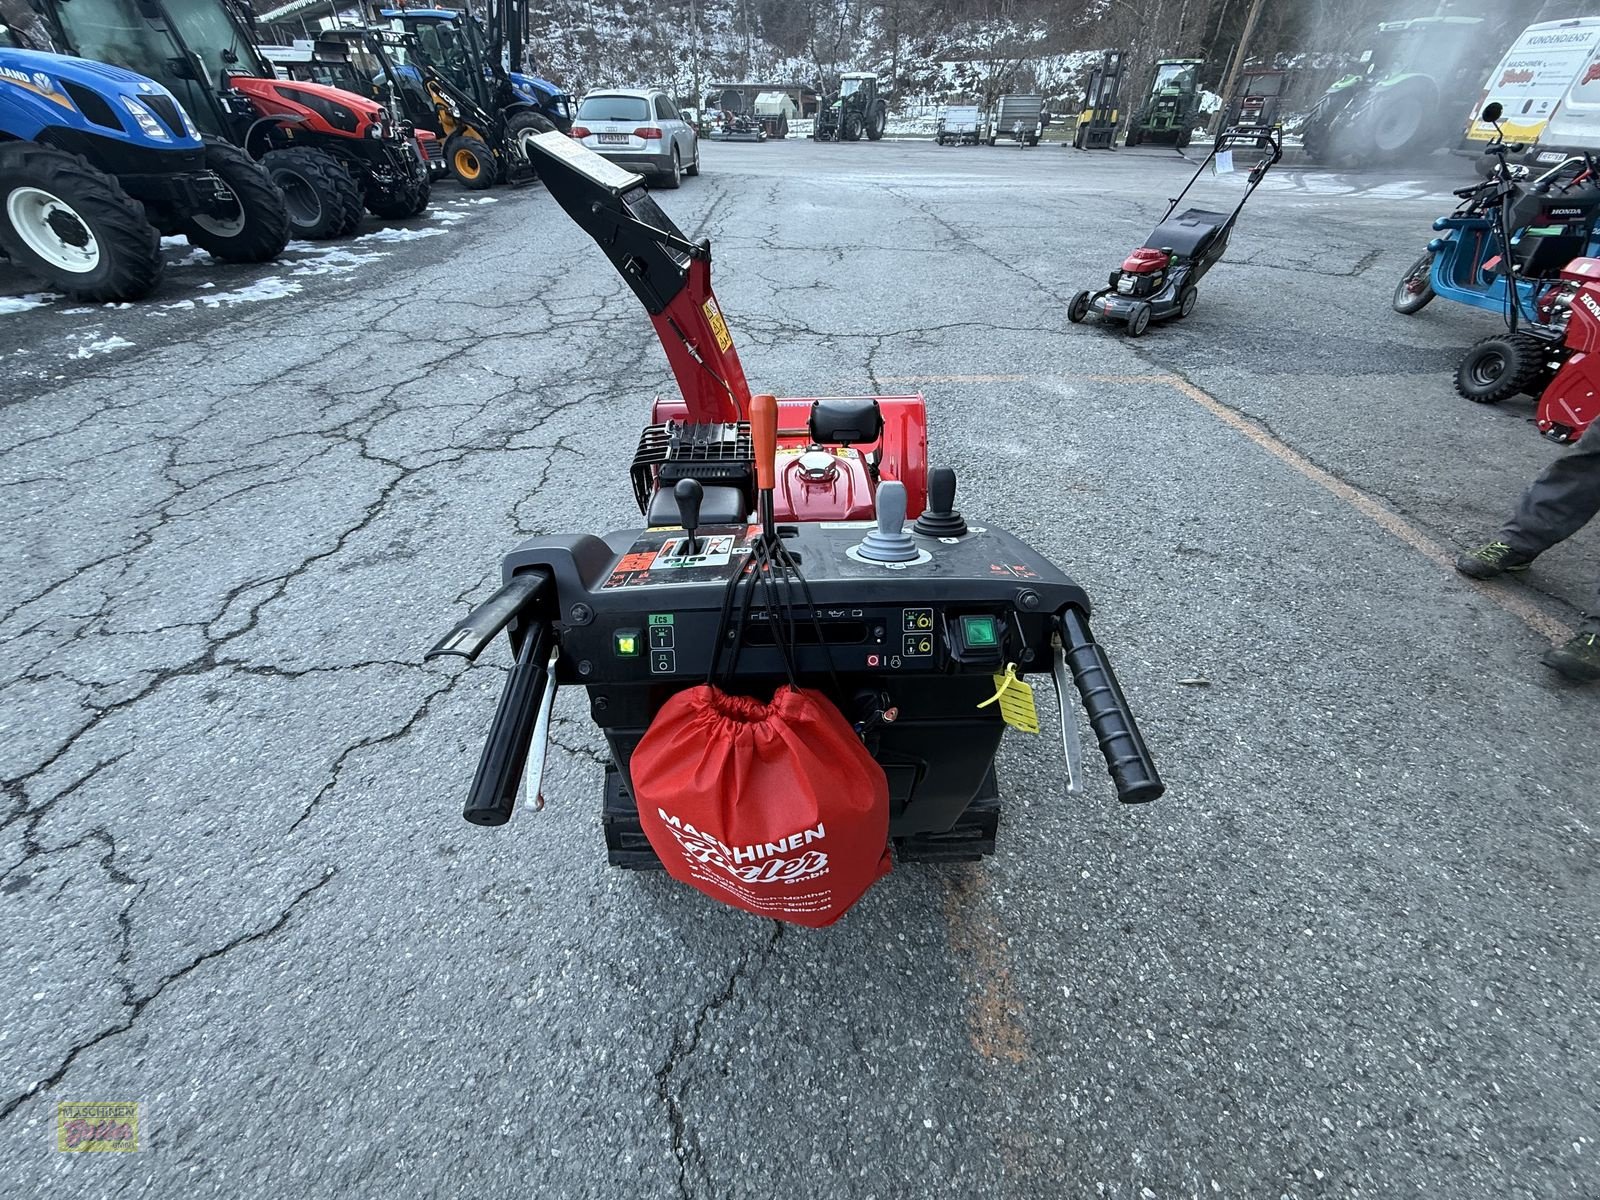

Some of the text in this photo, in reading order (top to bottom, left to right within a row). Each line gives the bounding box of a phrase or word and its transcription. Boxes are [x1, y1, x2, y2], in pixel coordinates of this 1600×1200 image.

[1527, 32, 1593, 45] KUNDENDIENST
[439, 90, 456, 107] JCB
[1580, 292, 1600, 322] HON
[784, 868, 830, 885] GmbH
